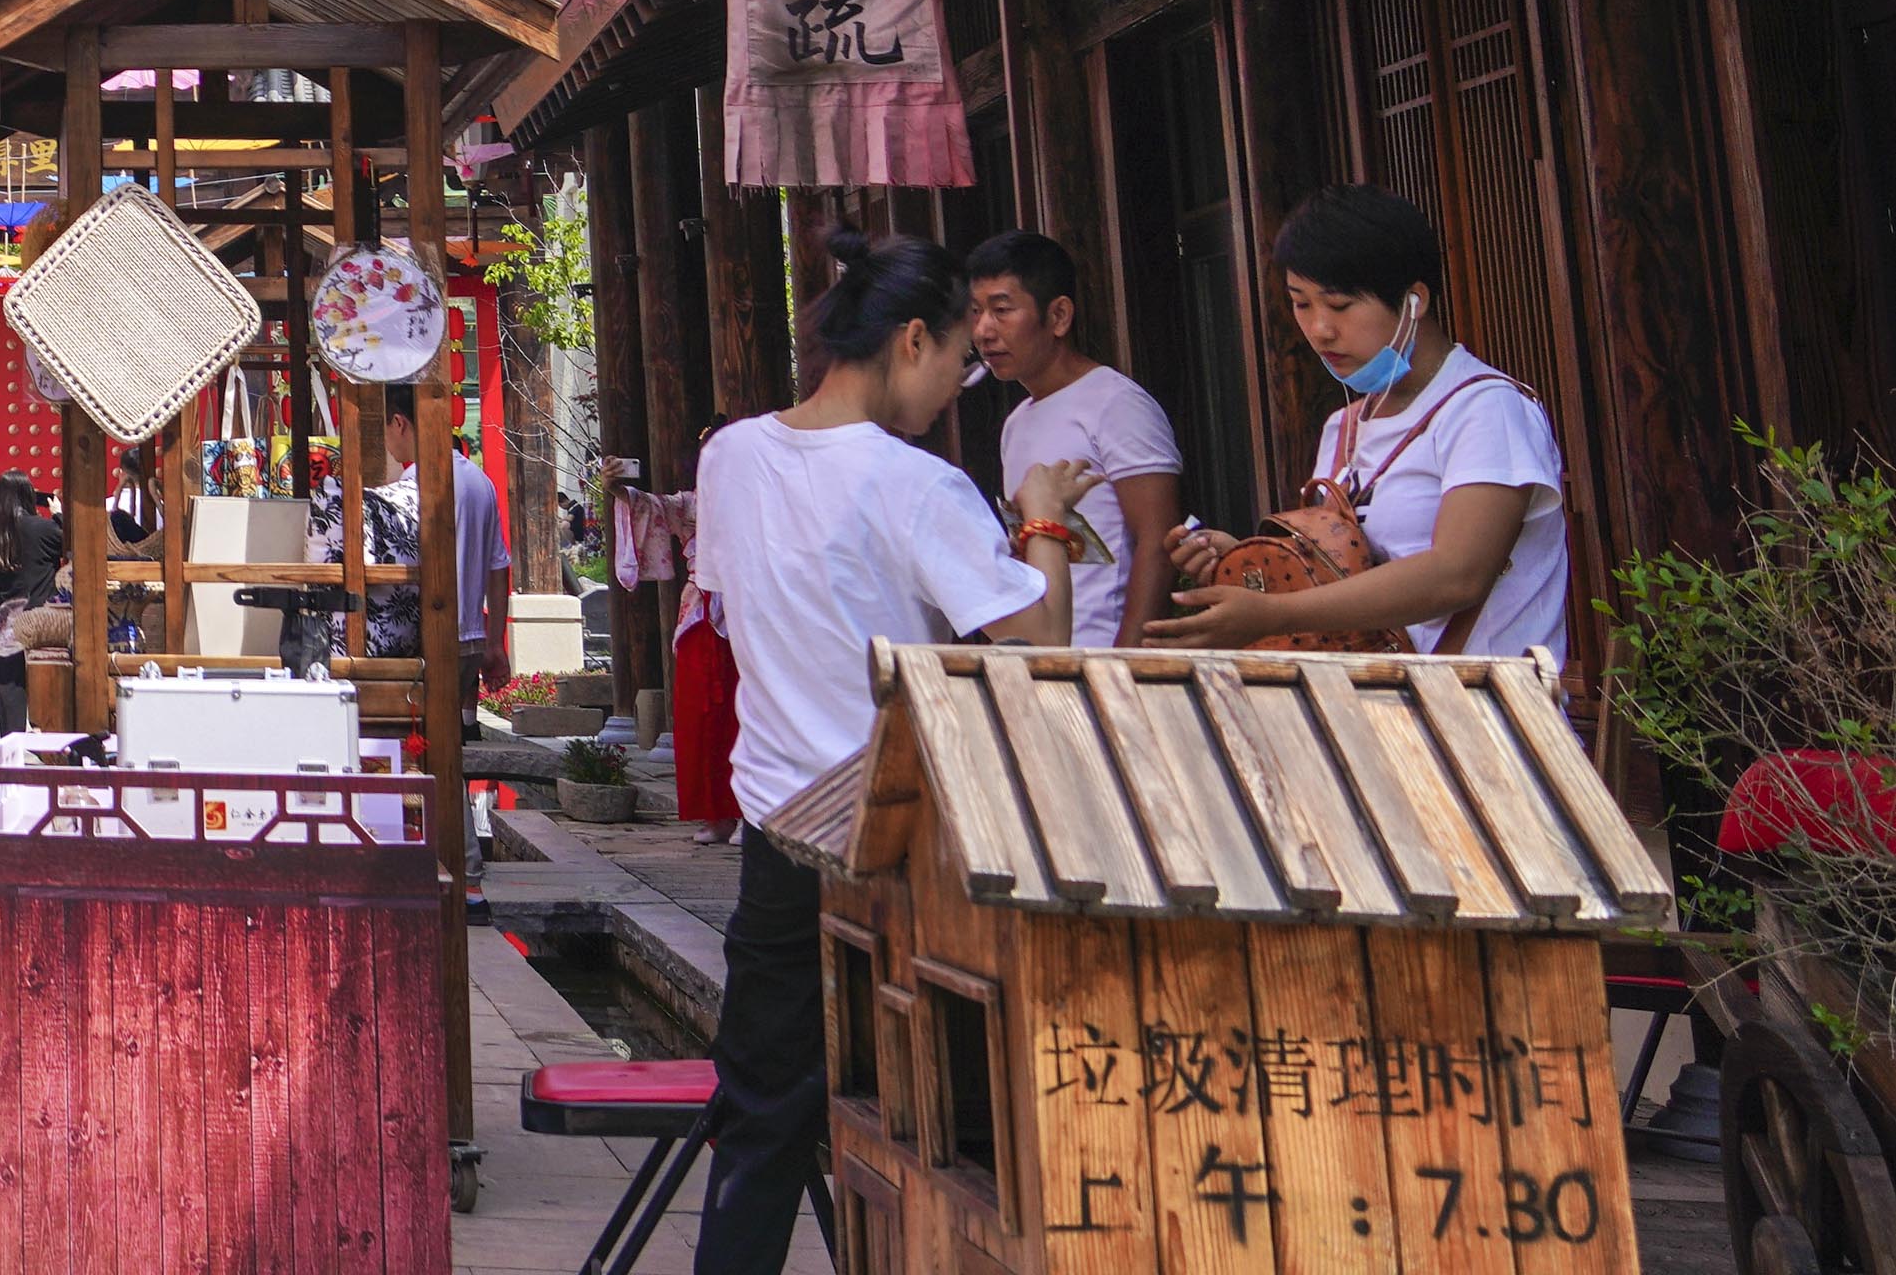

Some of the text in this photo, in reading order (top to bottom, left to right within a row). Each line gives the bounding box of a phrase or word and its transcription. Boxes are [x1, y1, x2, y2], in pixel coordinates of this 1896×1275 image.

[1045, 1021, 1593, 1129] 垃圾清理时间
